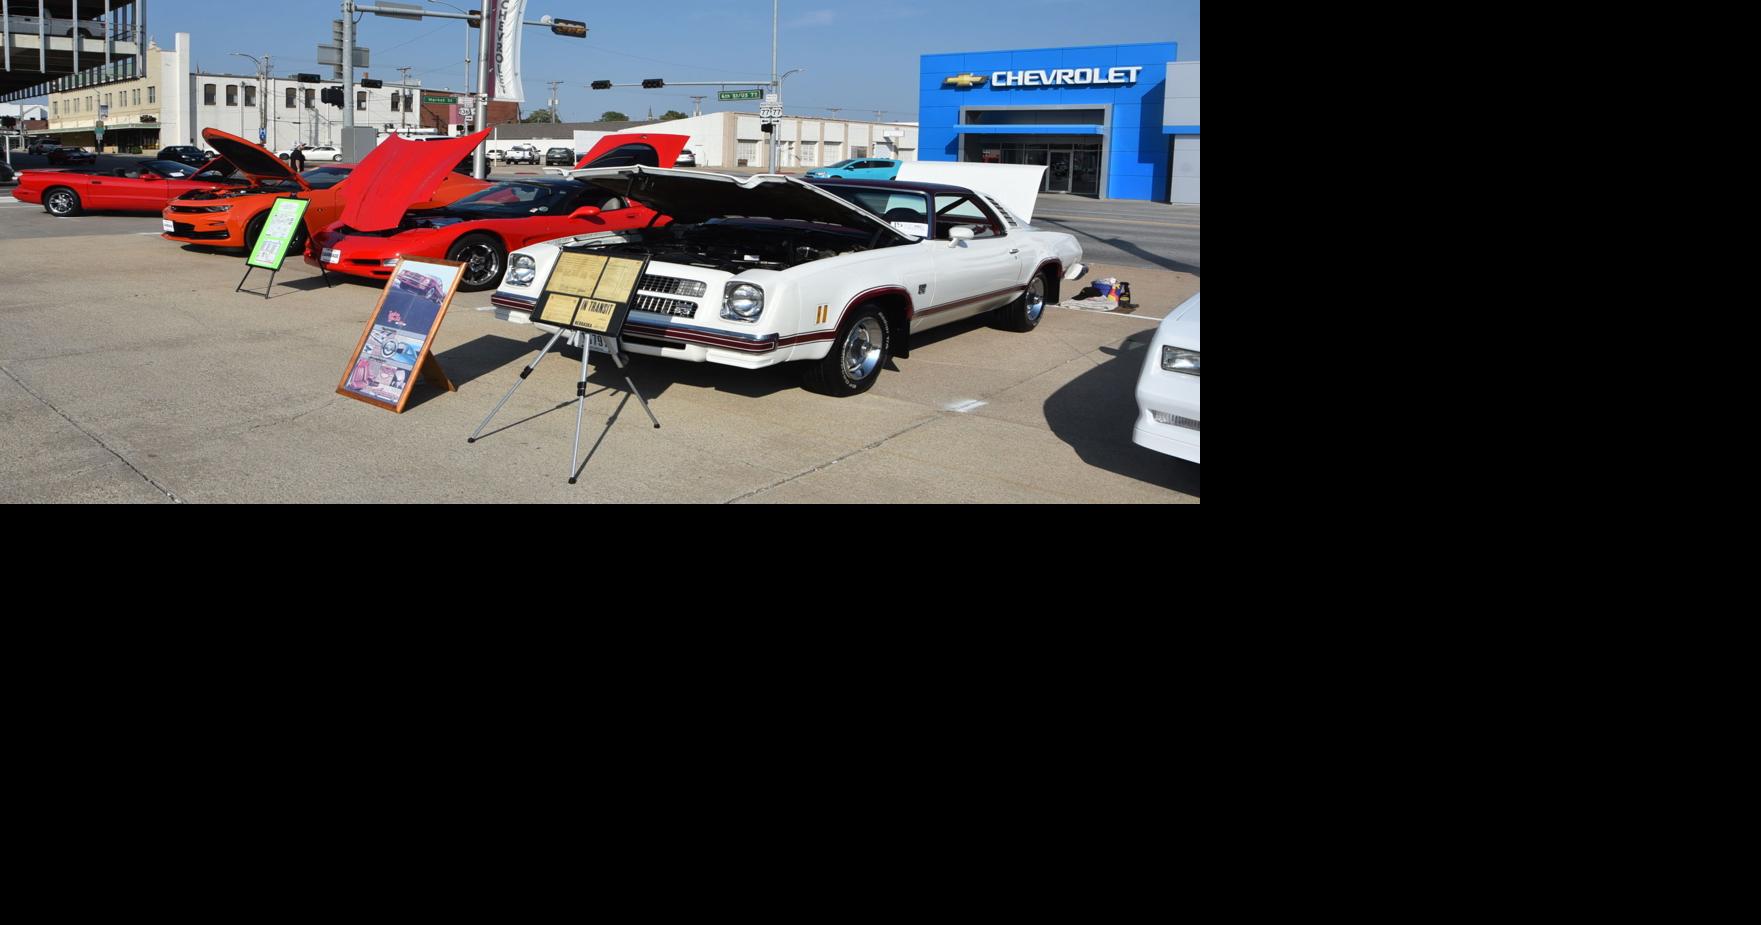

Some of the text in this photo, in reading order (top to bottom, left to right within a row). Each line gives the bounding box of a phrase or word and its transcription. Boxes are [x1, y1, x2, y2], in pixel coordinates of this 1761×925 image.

[495, 0, 510, 94] CHEVROLET
[991, 66, 1143, 87] CHEVROLET
[581, 300, 588, 311] IN
[588, 301, 614, 316] TRANSIT
